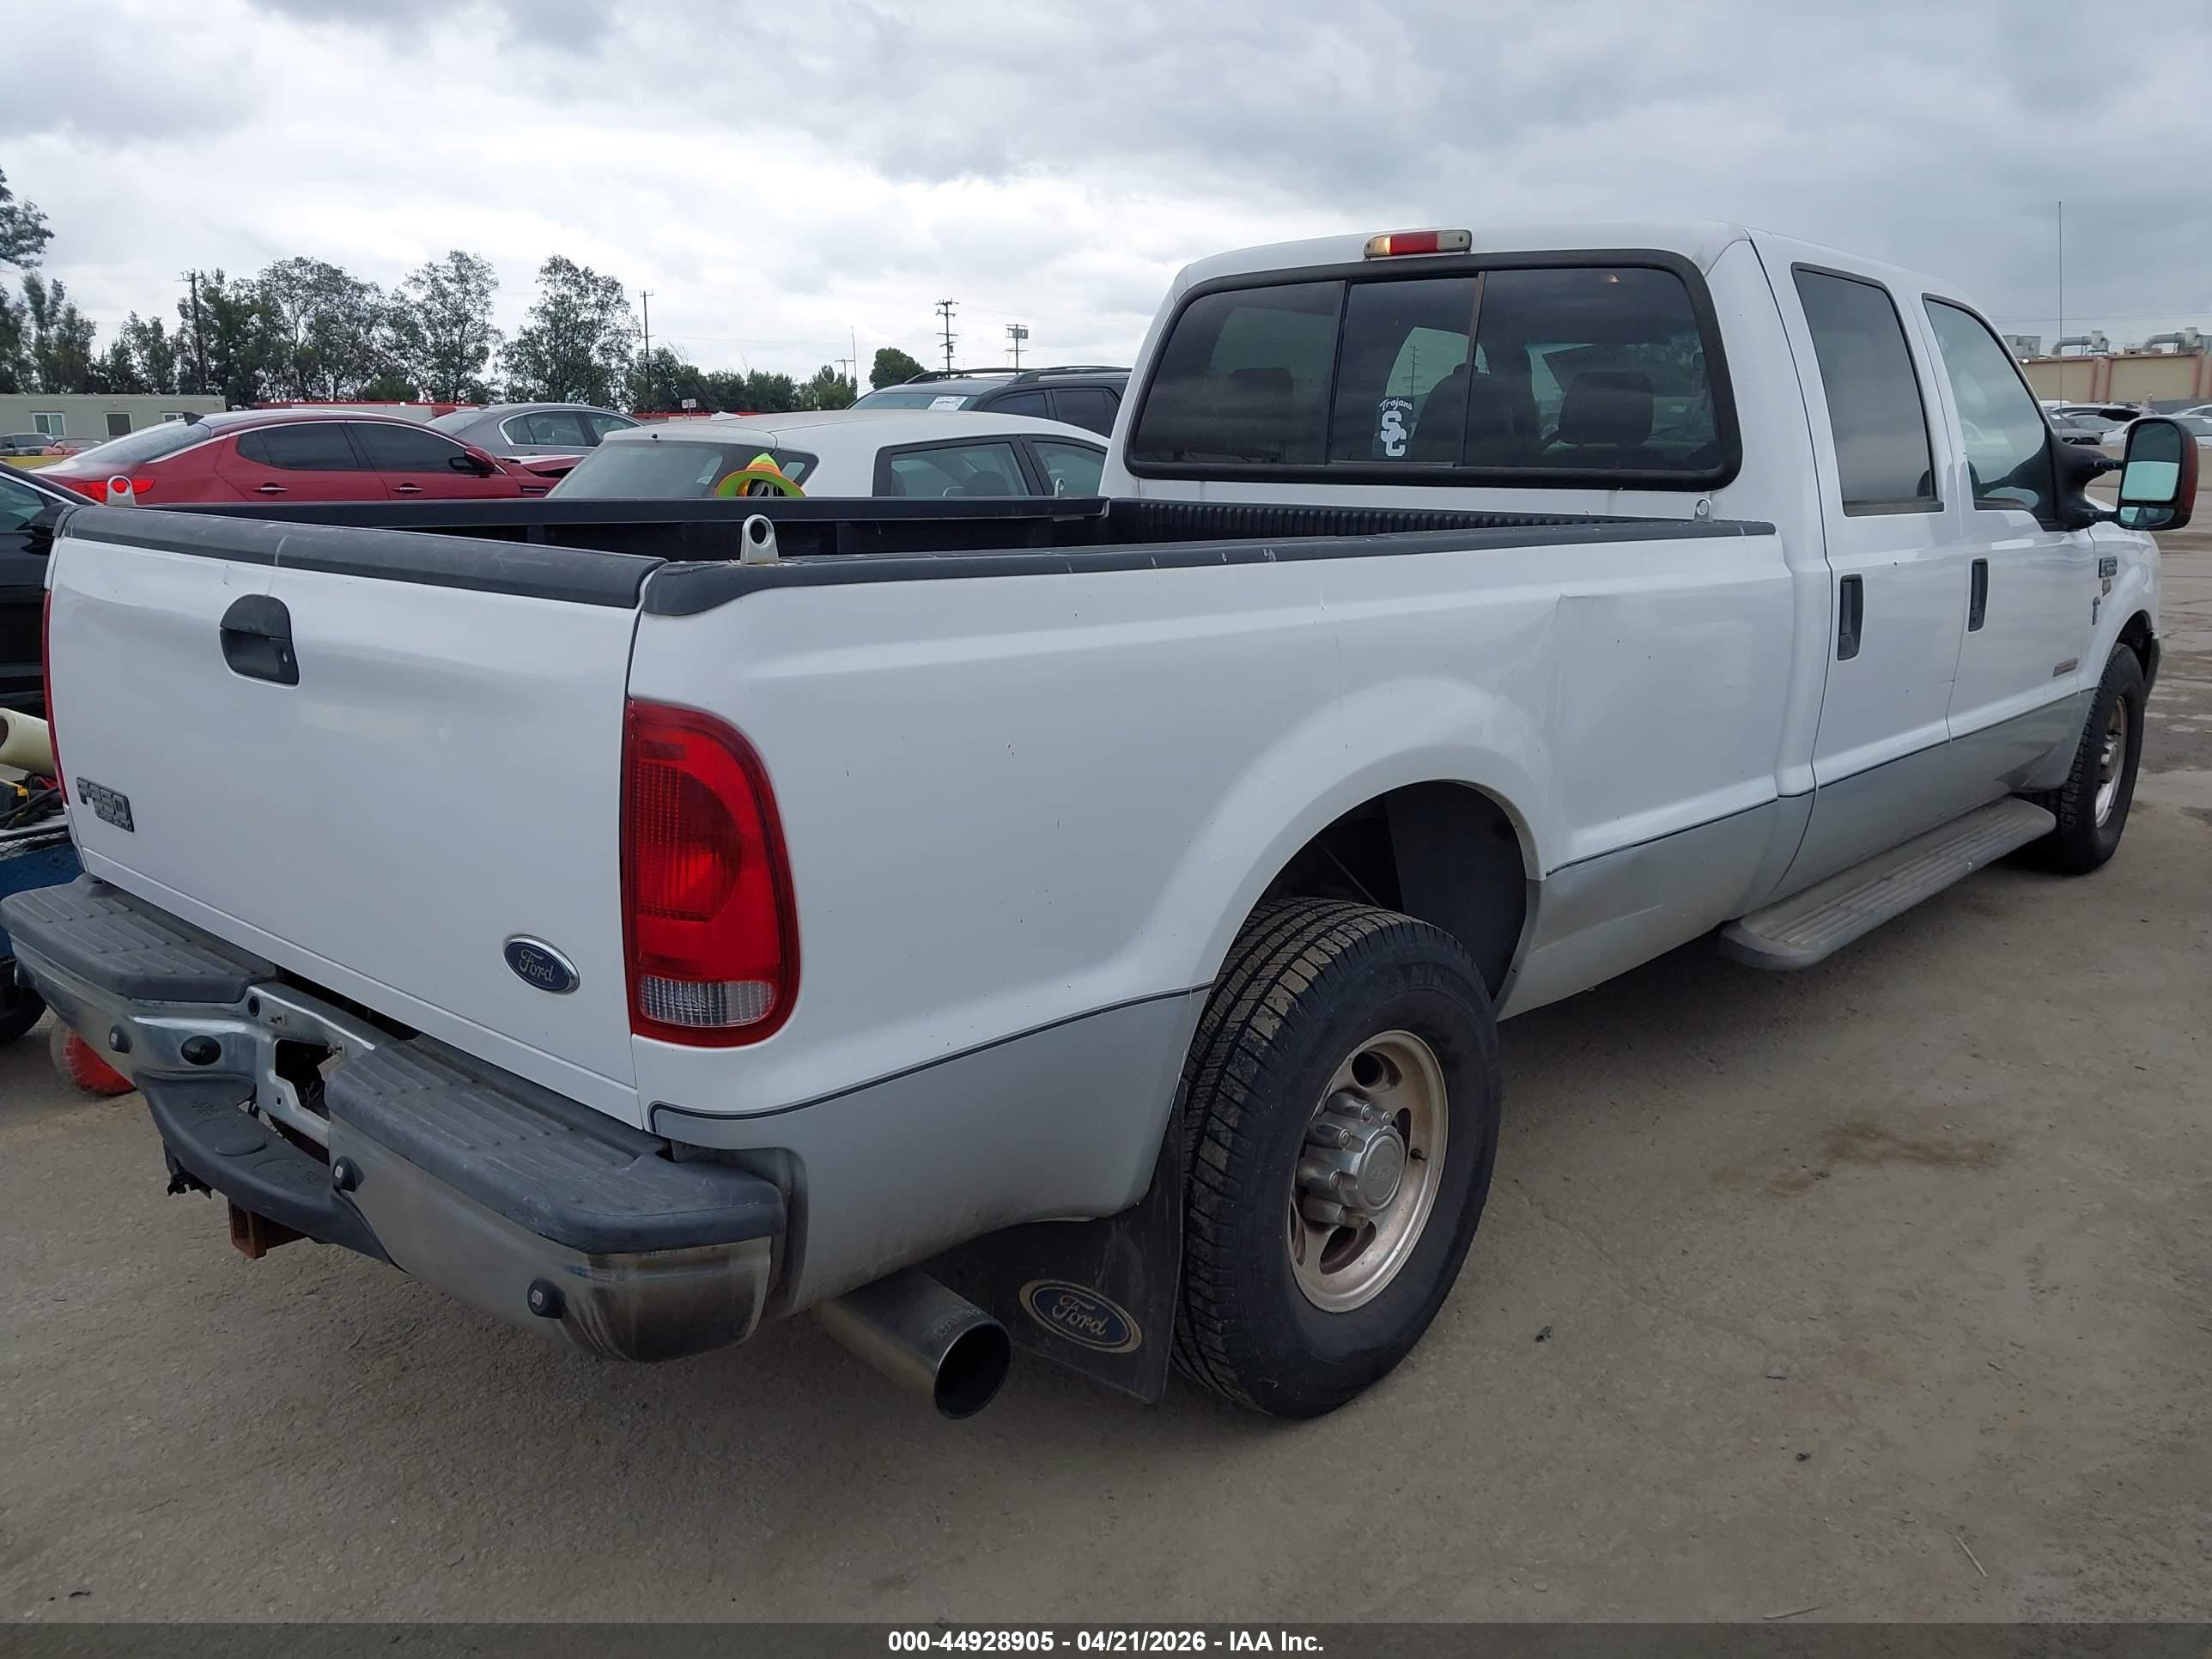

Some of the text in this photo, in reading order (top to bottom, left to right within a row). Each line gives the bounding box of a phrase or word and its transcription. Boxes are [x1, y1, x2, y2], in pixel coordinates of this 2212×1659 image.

[1379, 398, 1413, 411] Trojans
[1380, 410, 1407, 457] SC
[519, 949, 556, 982] Ford
[1052, 1295, 1109, 1335] Ford
